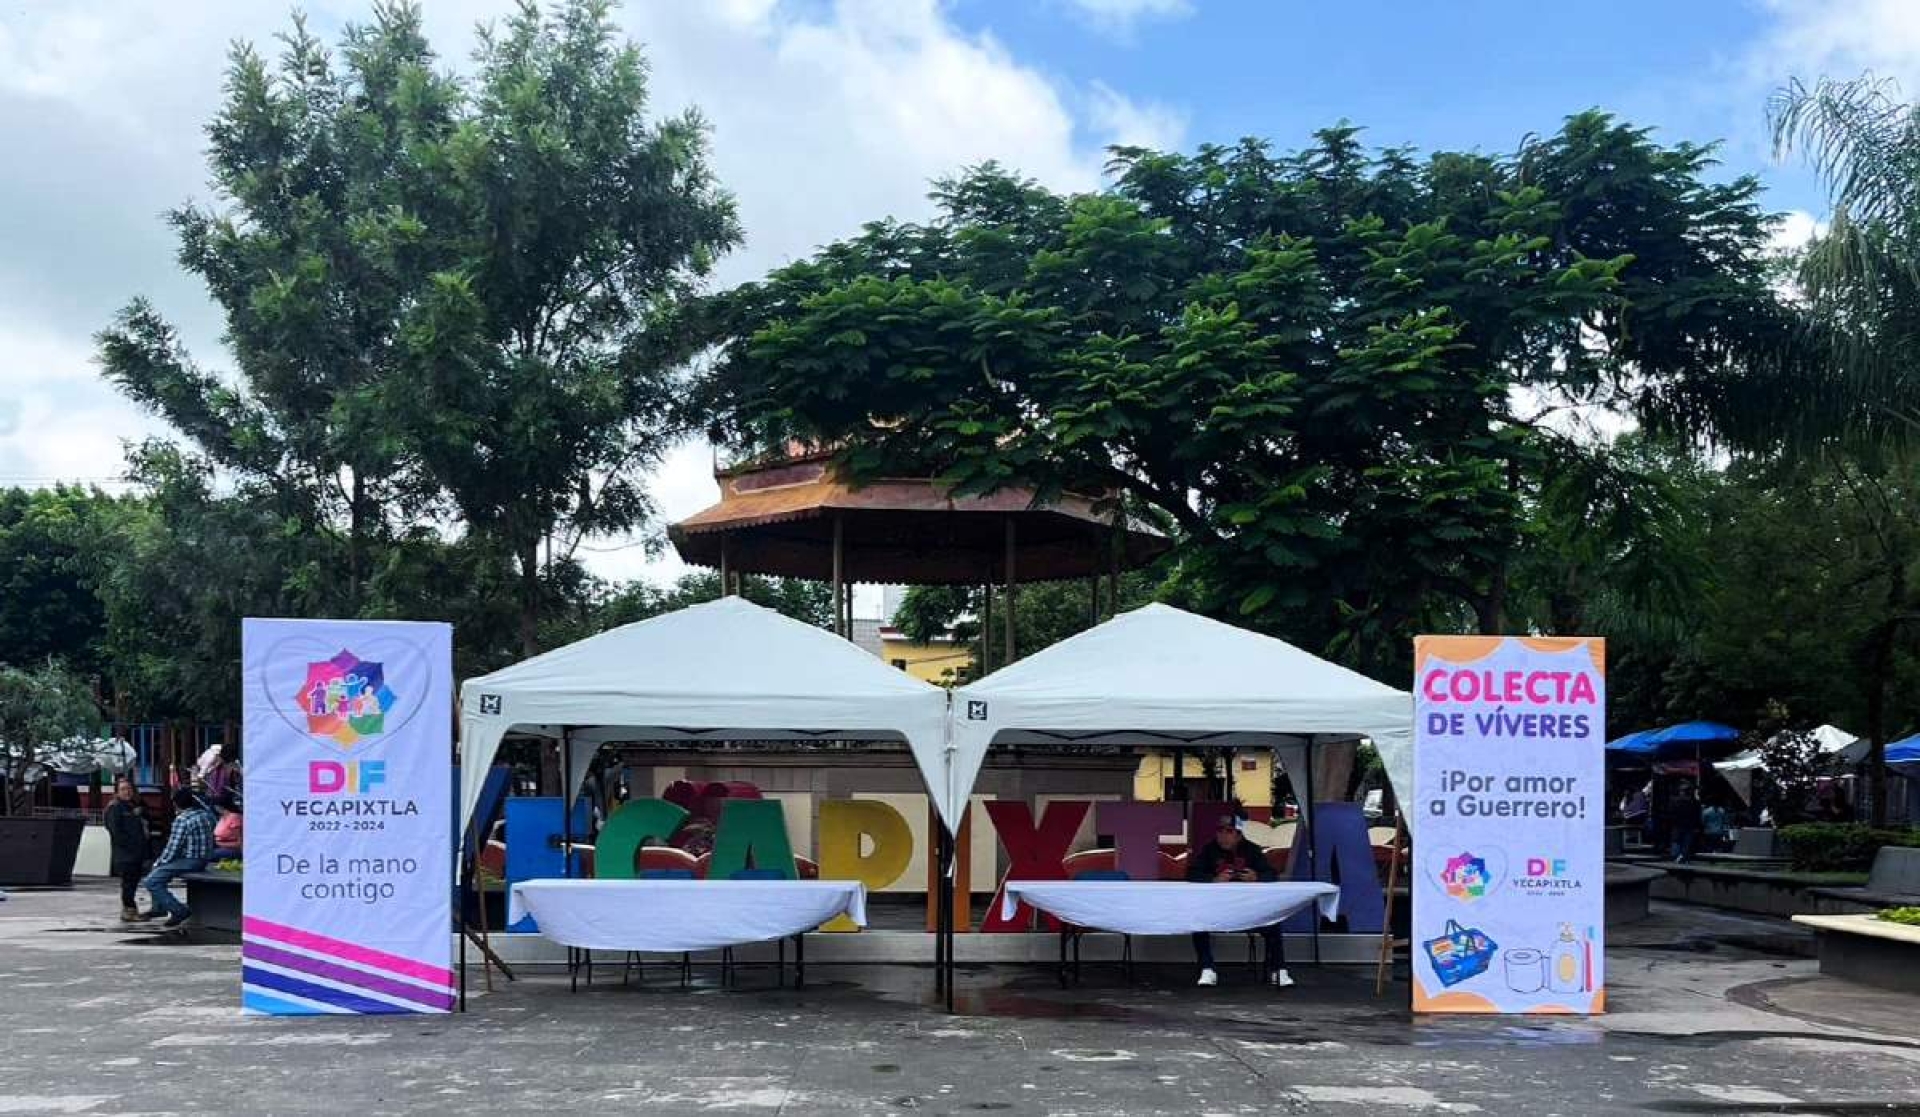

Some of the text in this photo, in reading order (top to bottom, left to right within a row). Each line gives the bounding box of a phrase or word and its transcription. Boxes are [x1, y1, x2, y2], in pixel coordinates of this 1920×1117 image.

[1424, 669, 1596, 704] COLECTA
[1428, 705, 1590, 738] DE VÍVERES
[308, 760, 386, 795] DIF
[1505, 776, 1577, 795] amor
[281, 800, 418, 816] YECAPIXTLA
[1430, 796, 1585, 819] a Guerrero!
[308, 821, 341, 832] 2022
[353, 821, 385, 832] 2024
[277, 854, 417, 875] De la mano
[301, 876, 395, 904] contigo
